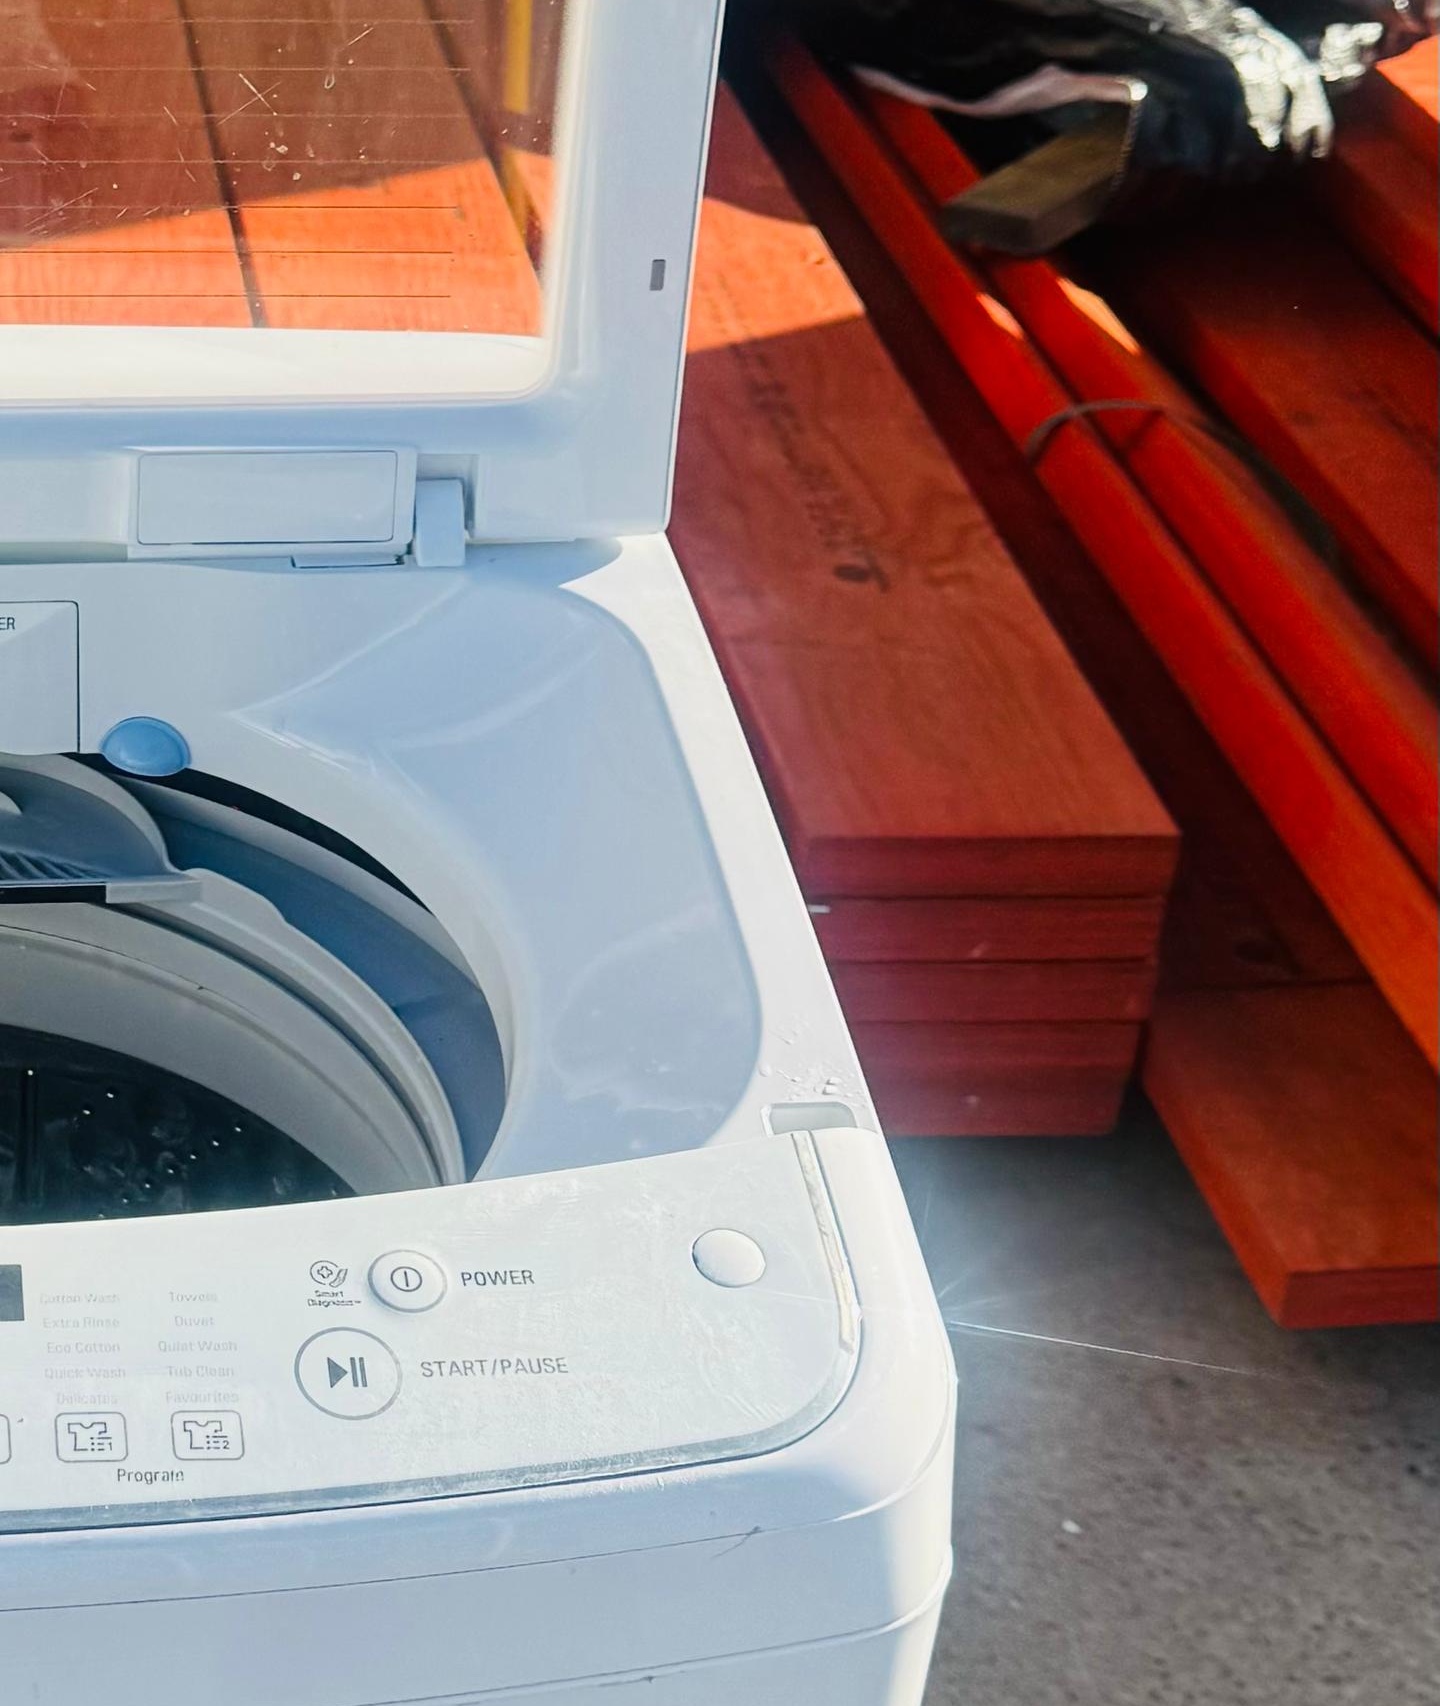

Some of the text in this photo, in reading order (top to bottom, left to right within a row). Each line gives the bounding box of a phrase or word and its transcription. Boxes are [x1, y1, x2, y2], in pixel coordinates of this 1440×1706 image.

[460, 1269, 536, 1287] POWER
[46, 1340, 121, 1354] Eco Cotton
[196, 1340, 238, 1353] Wash
[85, 1365, 127, 1379] Wash
[166, 1365, 235, 1378] Tub Clean
[419, 1356, 569, 1378] START/PAUSE
[165, 1390, 241, 1404] Favourites
[117, 1467, 185, 1486] Program
